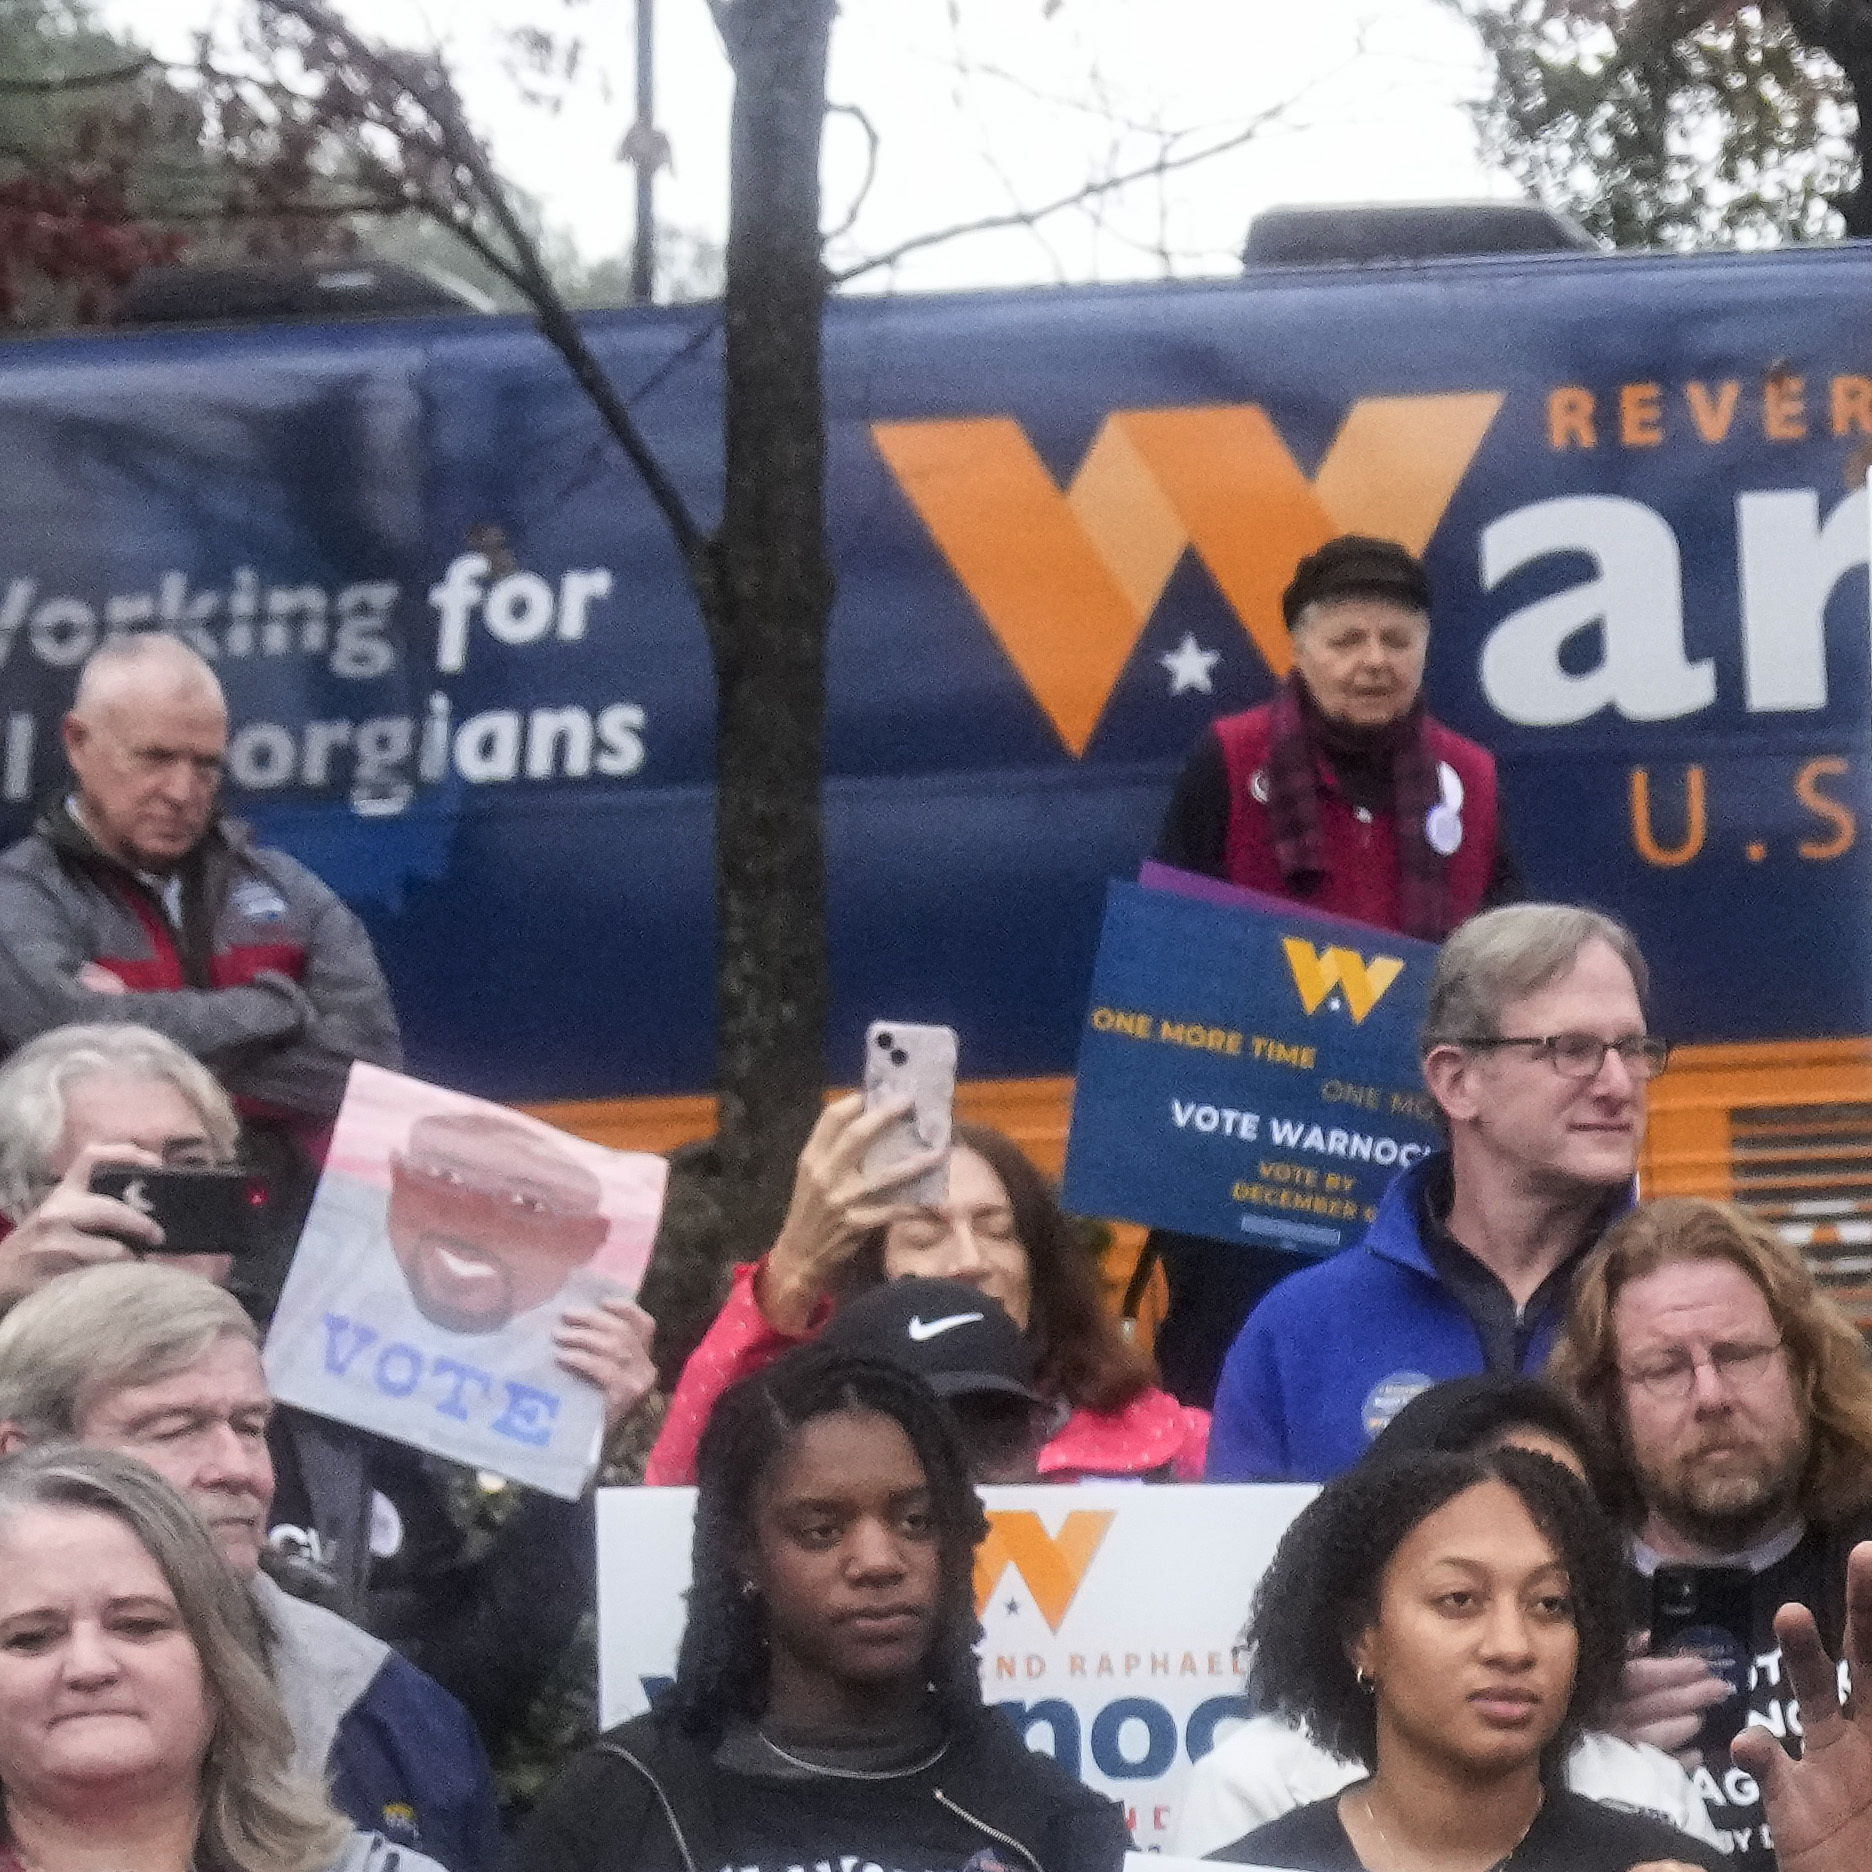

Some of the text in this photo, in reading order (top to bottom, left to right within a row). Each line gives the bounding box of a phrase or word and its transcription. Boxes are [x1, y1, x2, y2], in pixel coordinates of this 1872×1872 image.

[429, 554, 614, 673] for
[228, 692, 646, 817] orgians
[1628, 756, 1858, 868] U.S
[1091, 1006, 1317, 1069] ONE MORE TIME
[1321, 1078, 1381, 1111] ONE
[1170, 1098, 1432, 1168] VOTE WARNOC
[1231, 1181, 1357, 1222] DECEMBER
[1260, 1160, 1355, 1191] VOTE BY
[321, 1311, 563, 1448] VOTE
[1069, 1652, 1246, 1678] RAPHAEL
